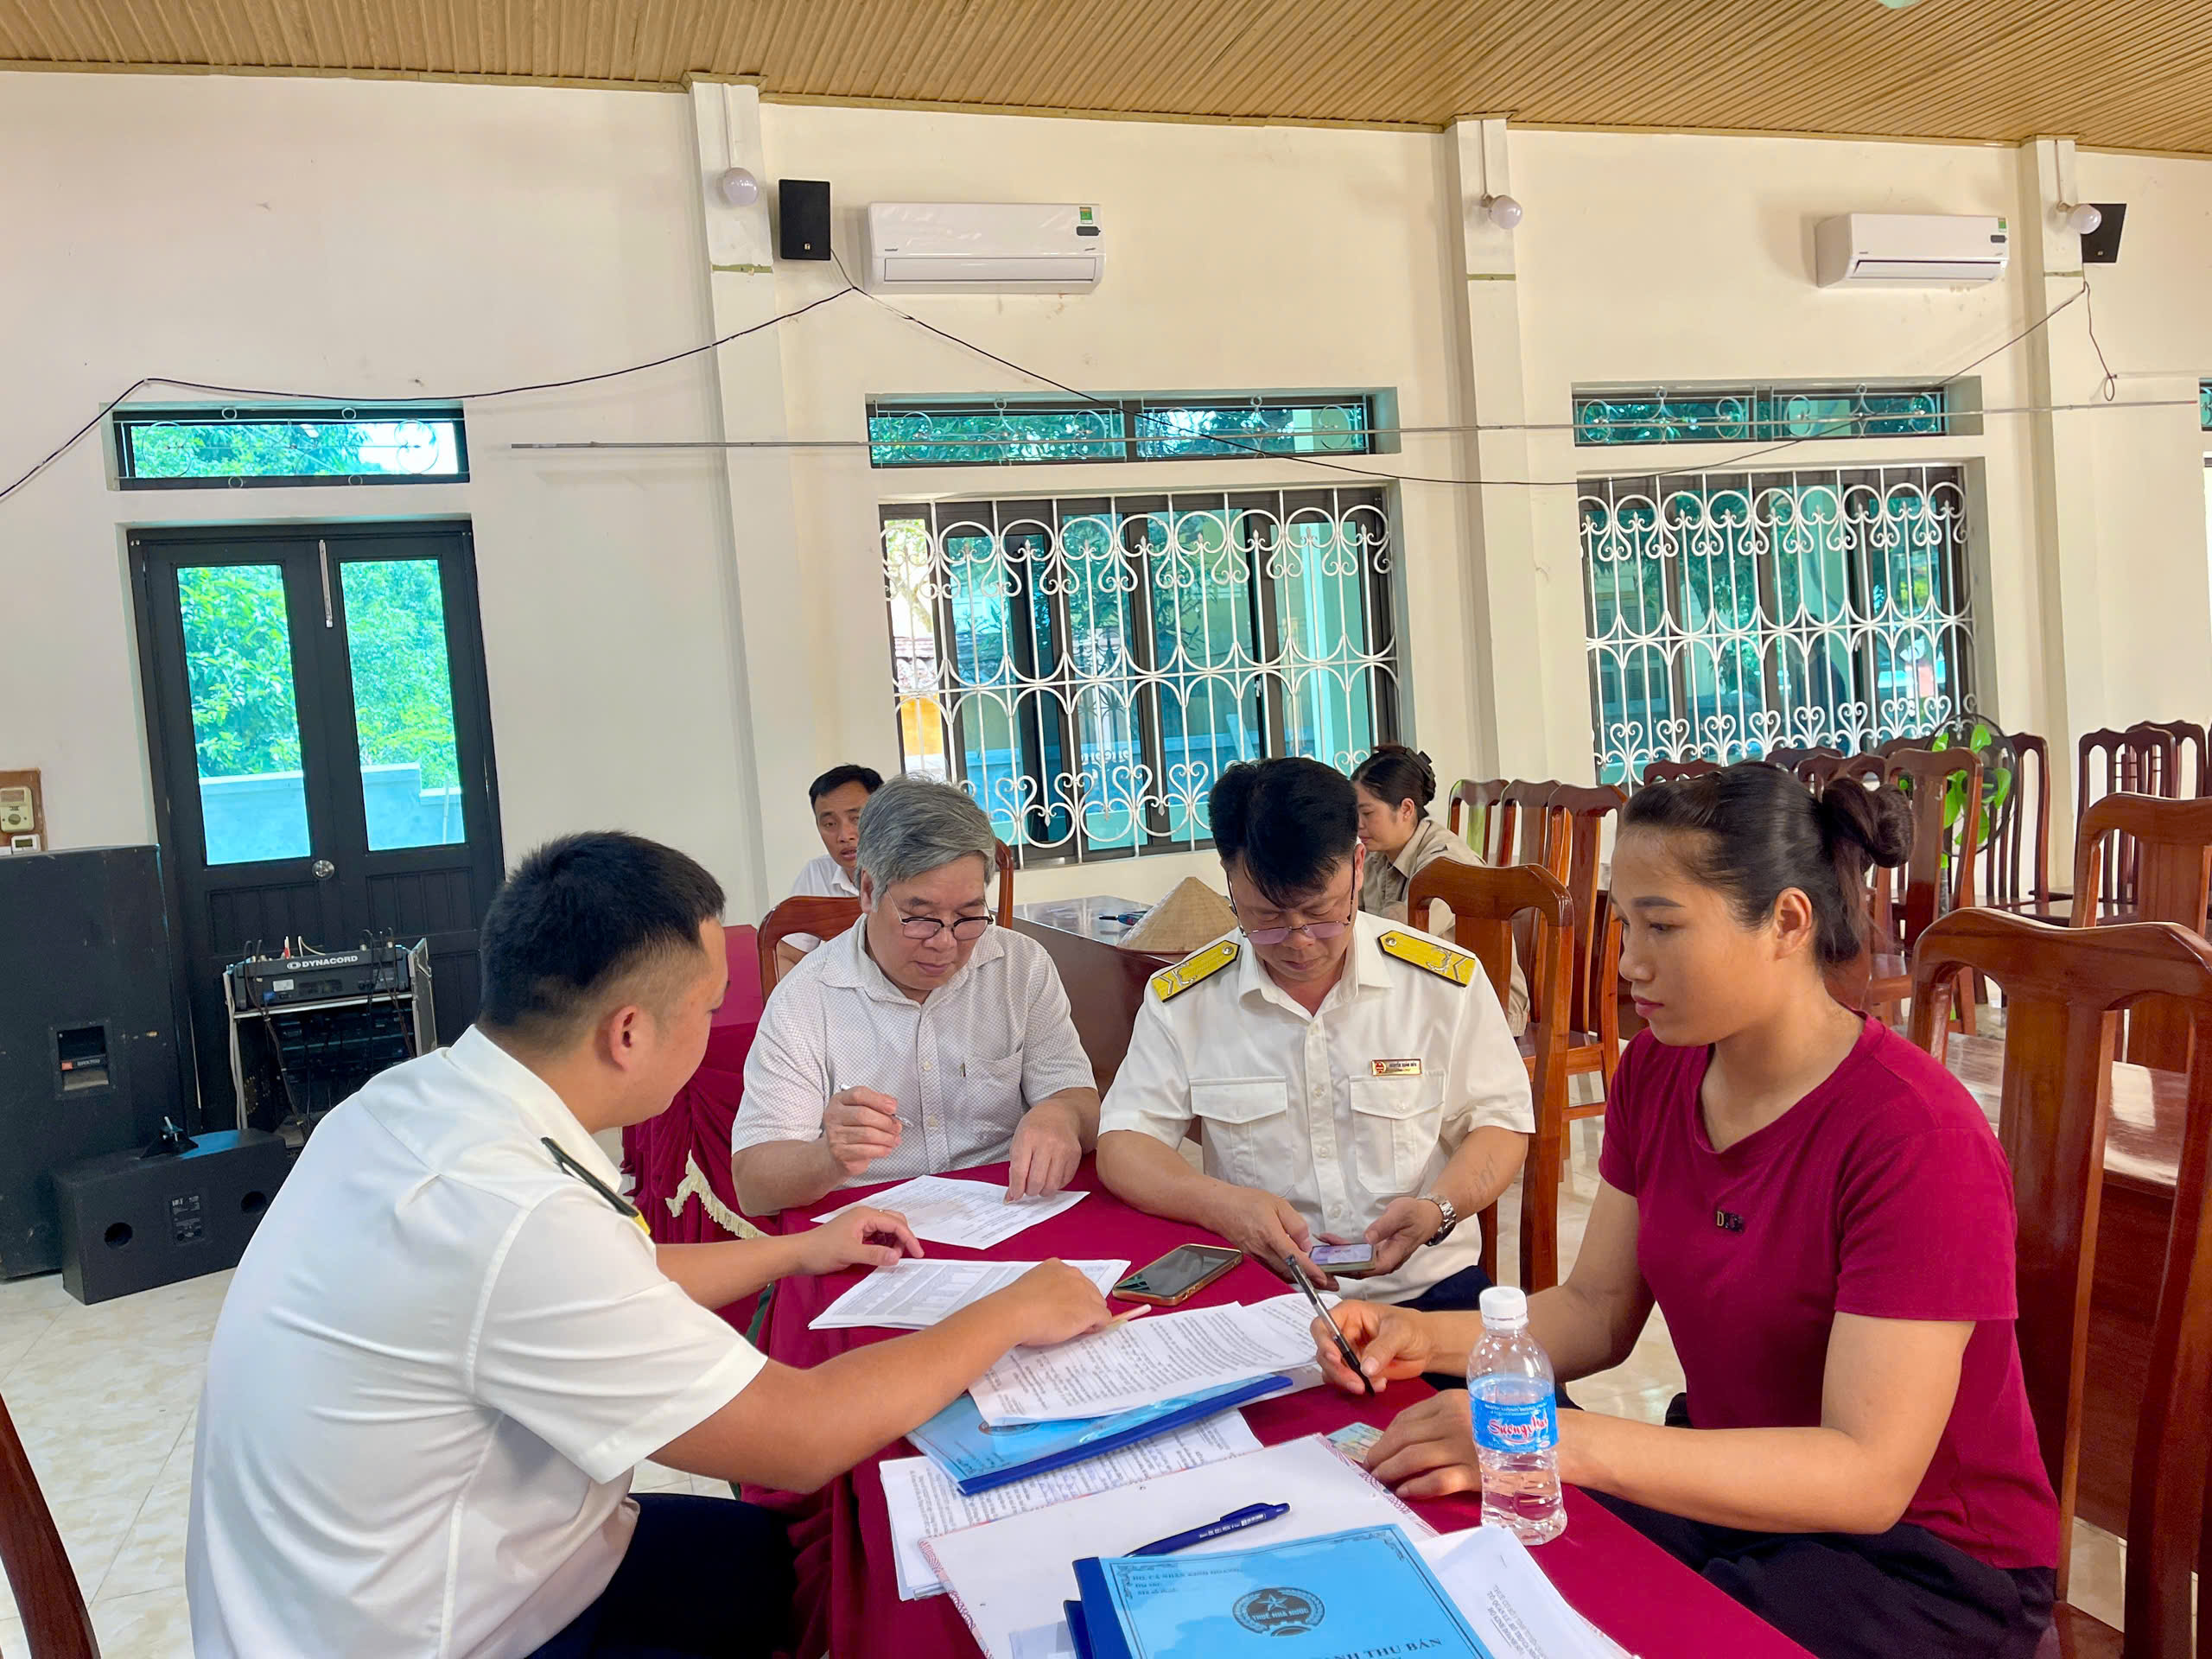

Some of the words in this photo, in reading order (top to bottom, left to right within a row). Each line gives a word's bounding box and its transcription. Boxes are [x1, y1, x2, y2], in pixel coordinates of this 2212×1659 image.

[302, 955, 359, 968] DYNACORD
[1363, 1645, 1402, 1658] THU
[1406, 1638, 1443, 1651] BÁN
